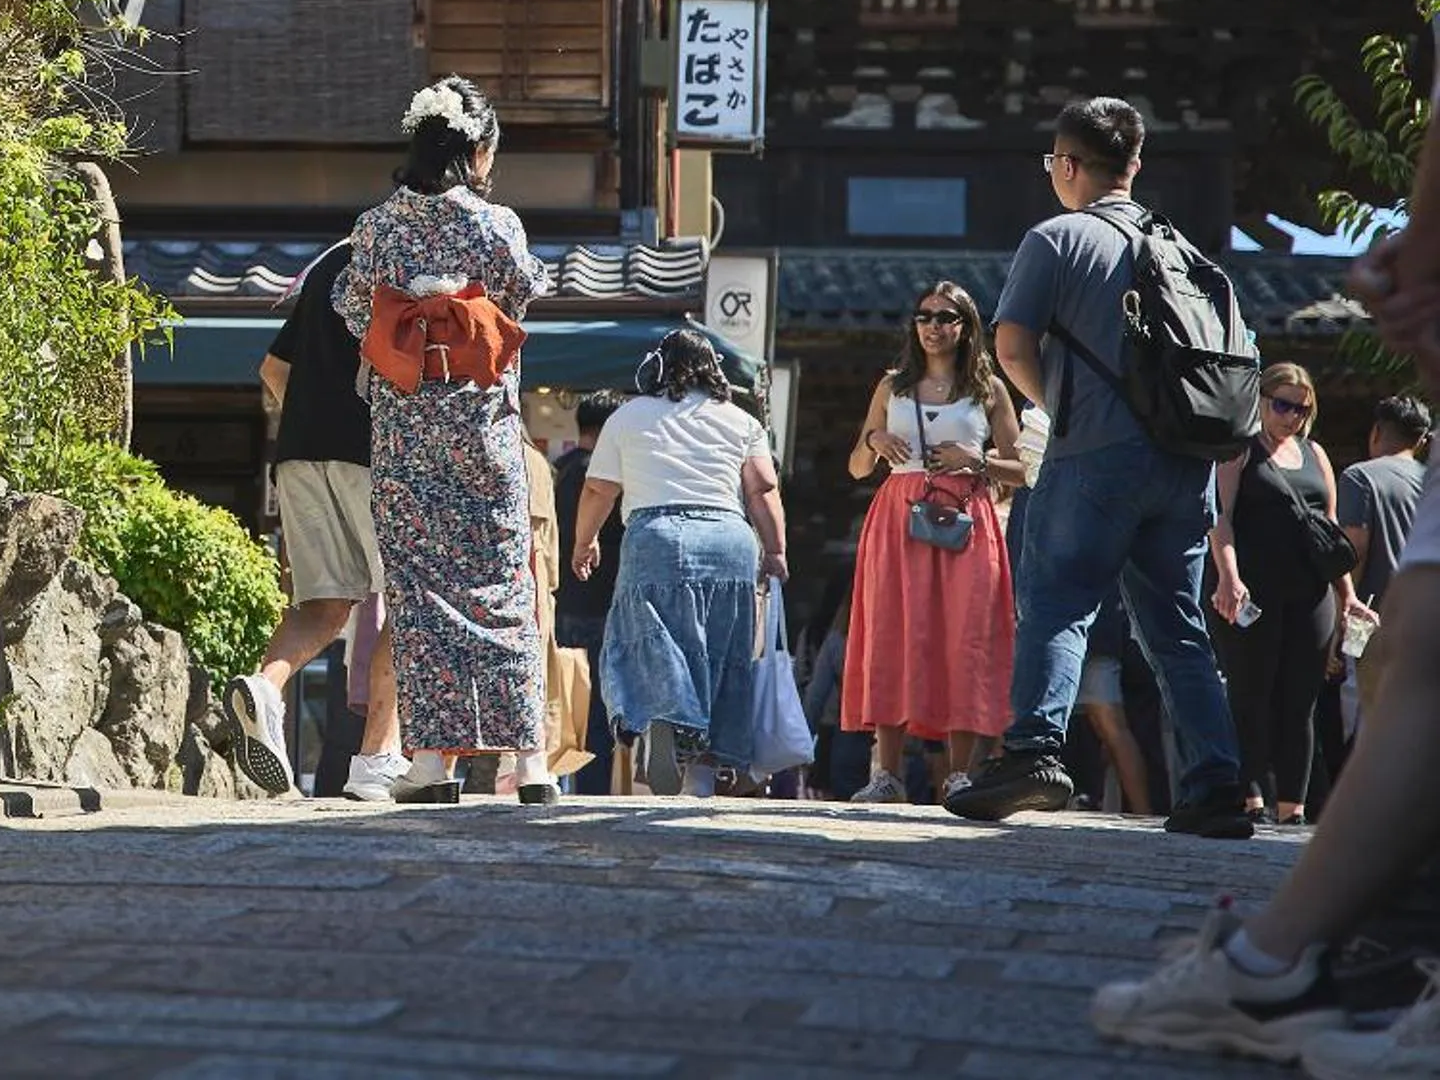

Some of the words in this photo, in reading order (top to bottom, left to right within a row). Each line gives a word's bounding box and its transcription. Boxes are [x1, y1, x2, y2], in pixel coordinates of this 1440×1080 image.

[683, 7, 721, 127] たばこ
[725, 27, 749, 110] やさか
